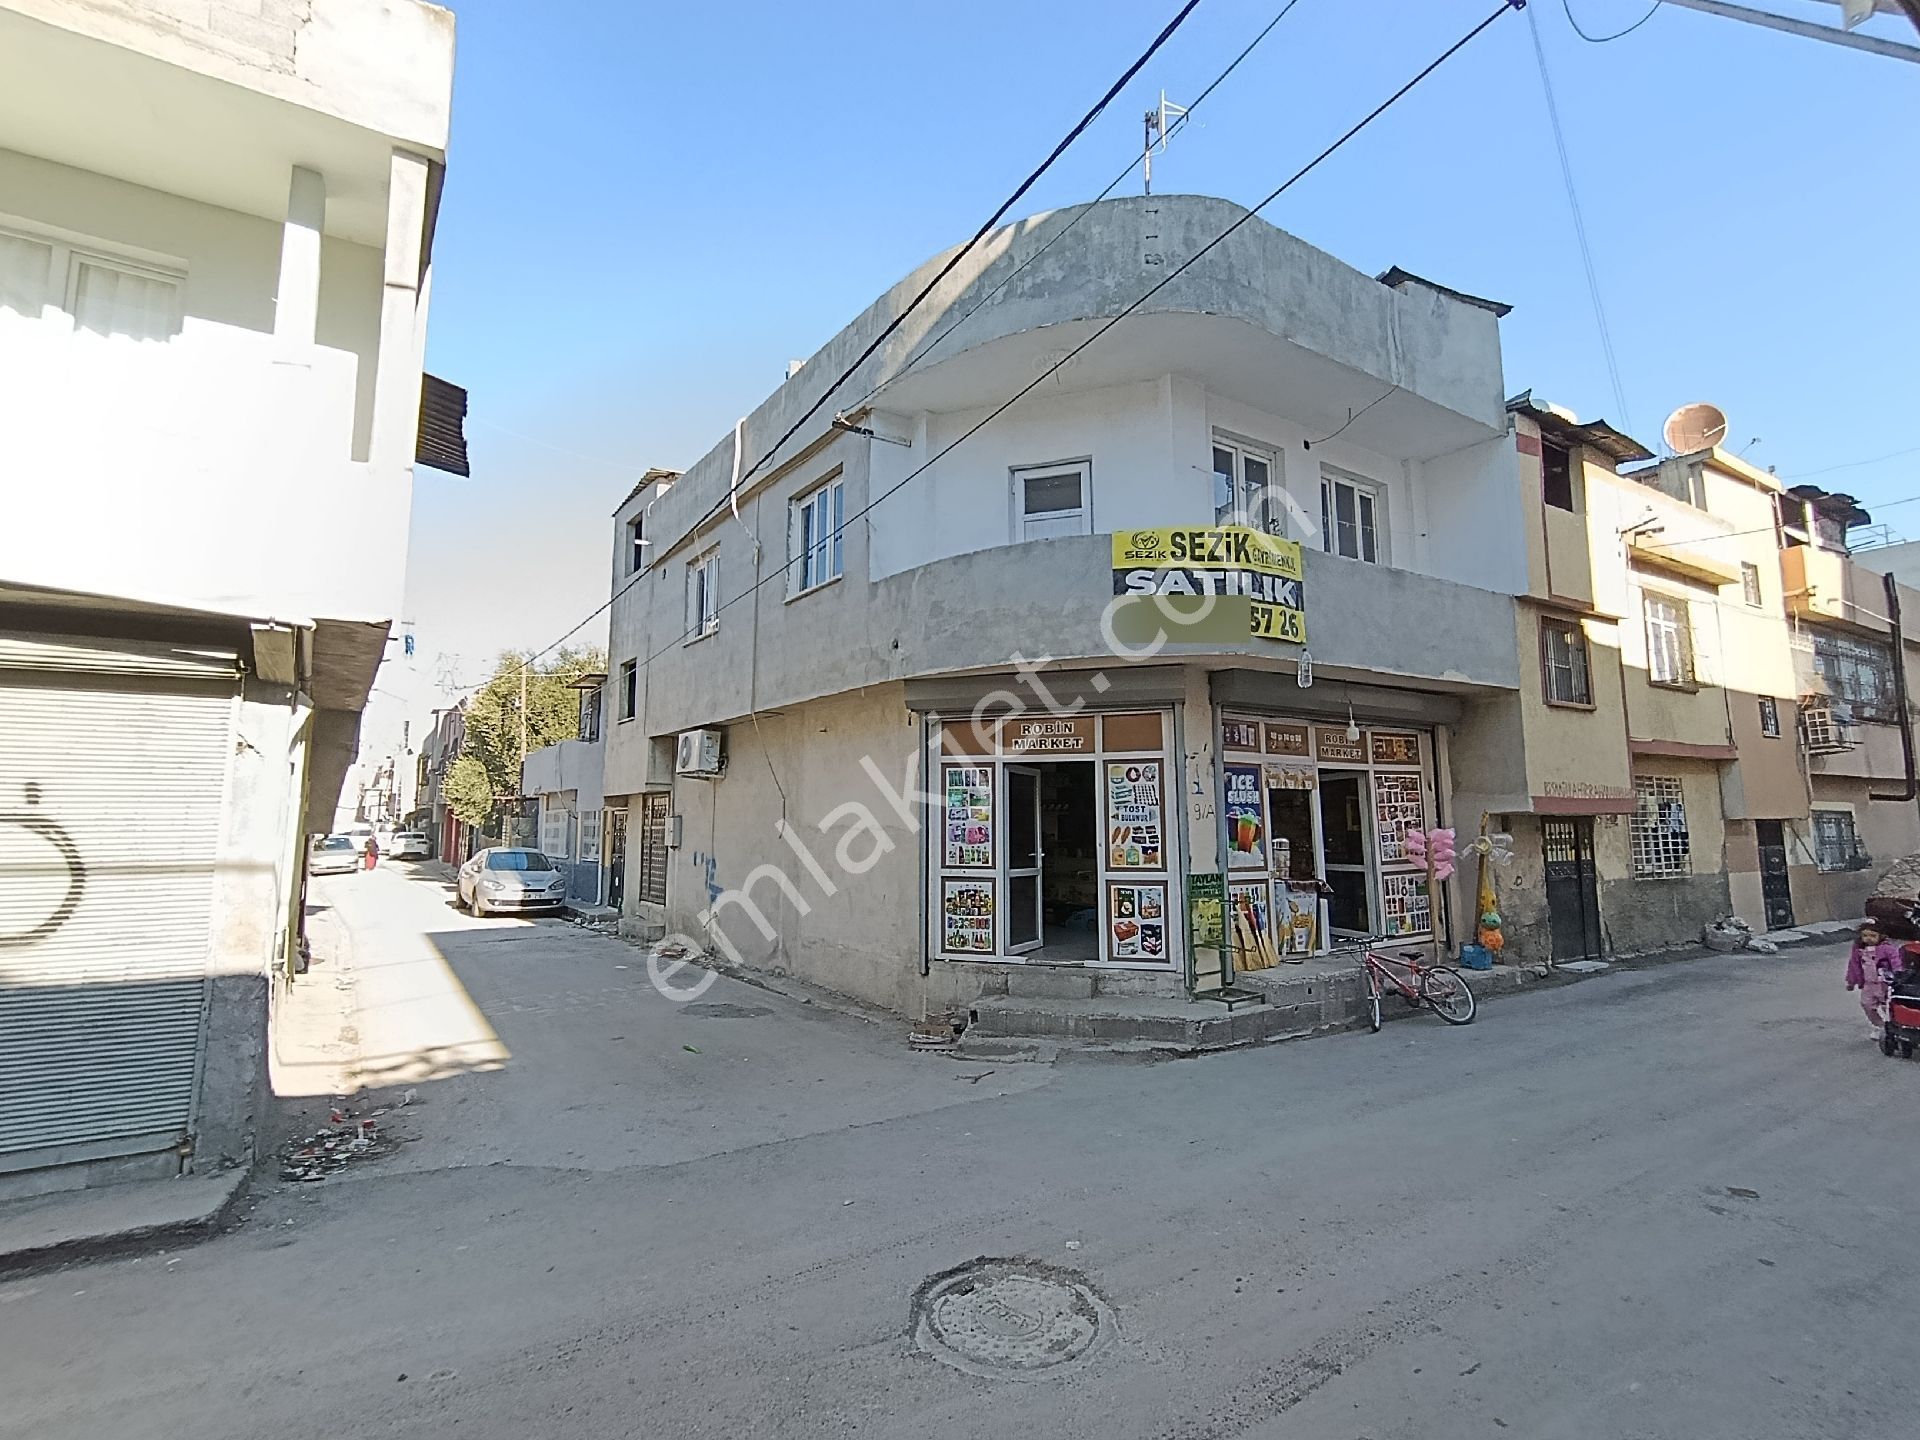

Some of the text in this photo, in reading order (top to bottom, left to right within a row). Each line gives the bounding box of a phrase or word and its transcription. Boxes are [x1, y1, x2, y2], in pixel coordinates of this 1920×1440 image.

[1170, 531, 1252, 564] SEZİK
[1125, 570, 1297, 608] SATILIK
[1279, 609, 1299, 639] 26
[1021, 720, 1074, 736] ROBİN
[1012, 737, 1084, 750] MARKET
[1320, 746, 1362, 760] MARKET
[1231, 774, 1255, 791] ICE
[1227, 790, 1260, 804] SLUSH
[1123, 805, 1146, 813] TOST
[1193, 803, 1215, 820] 9/A
[1190, 874, 1222, 884] TAYLAN
